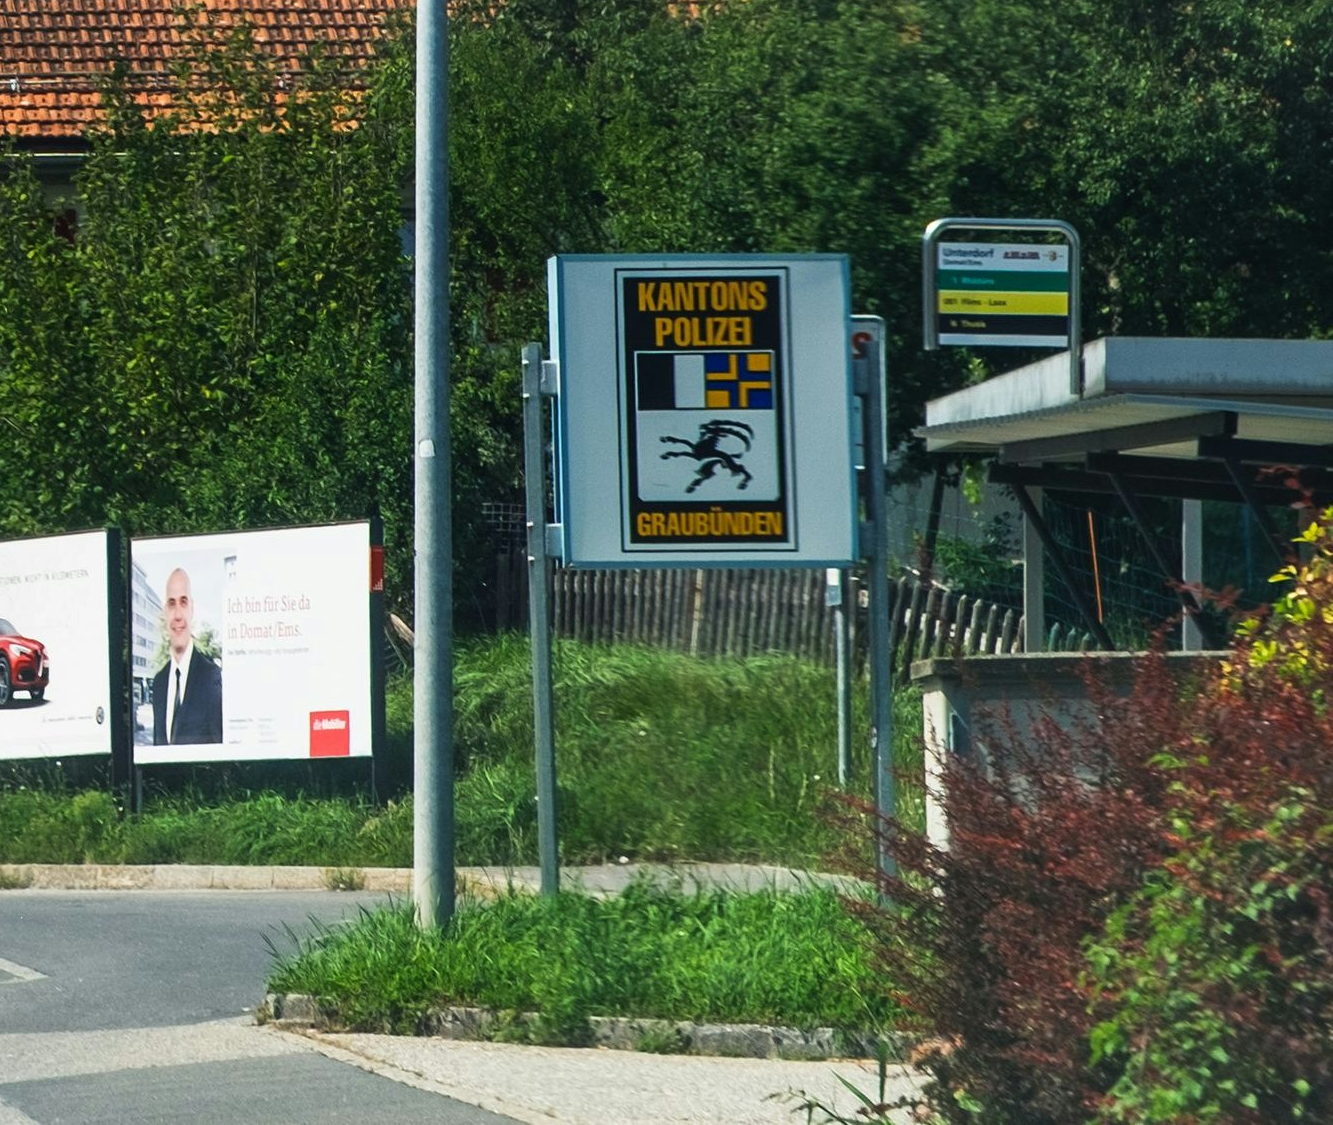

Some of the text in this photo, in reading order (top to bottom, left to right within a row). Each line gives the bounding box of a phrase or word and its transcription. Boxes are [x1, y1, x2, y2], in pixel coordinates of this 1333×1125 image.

[638, 281, 768, 312] KANTONS
[654, 317, 752, 347] POLIZEI
[637, 506, 783, 537] GRAUBÜNDEN
[228, 593, 311, 614] Ich bin für Sie da
[228, 623, 237, 640] in
